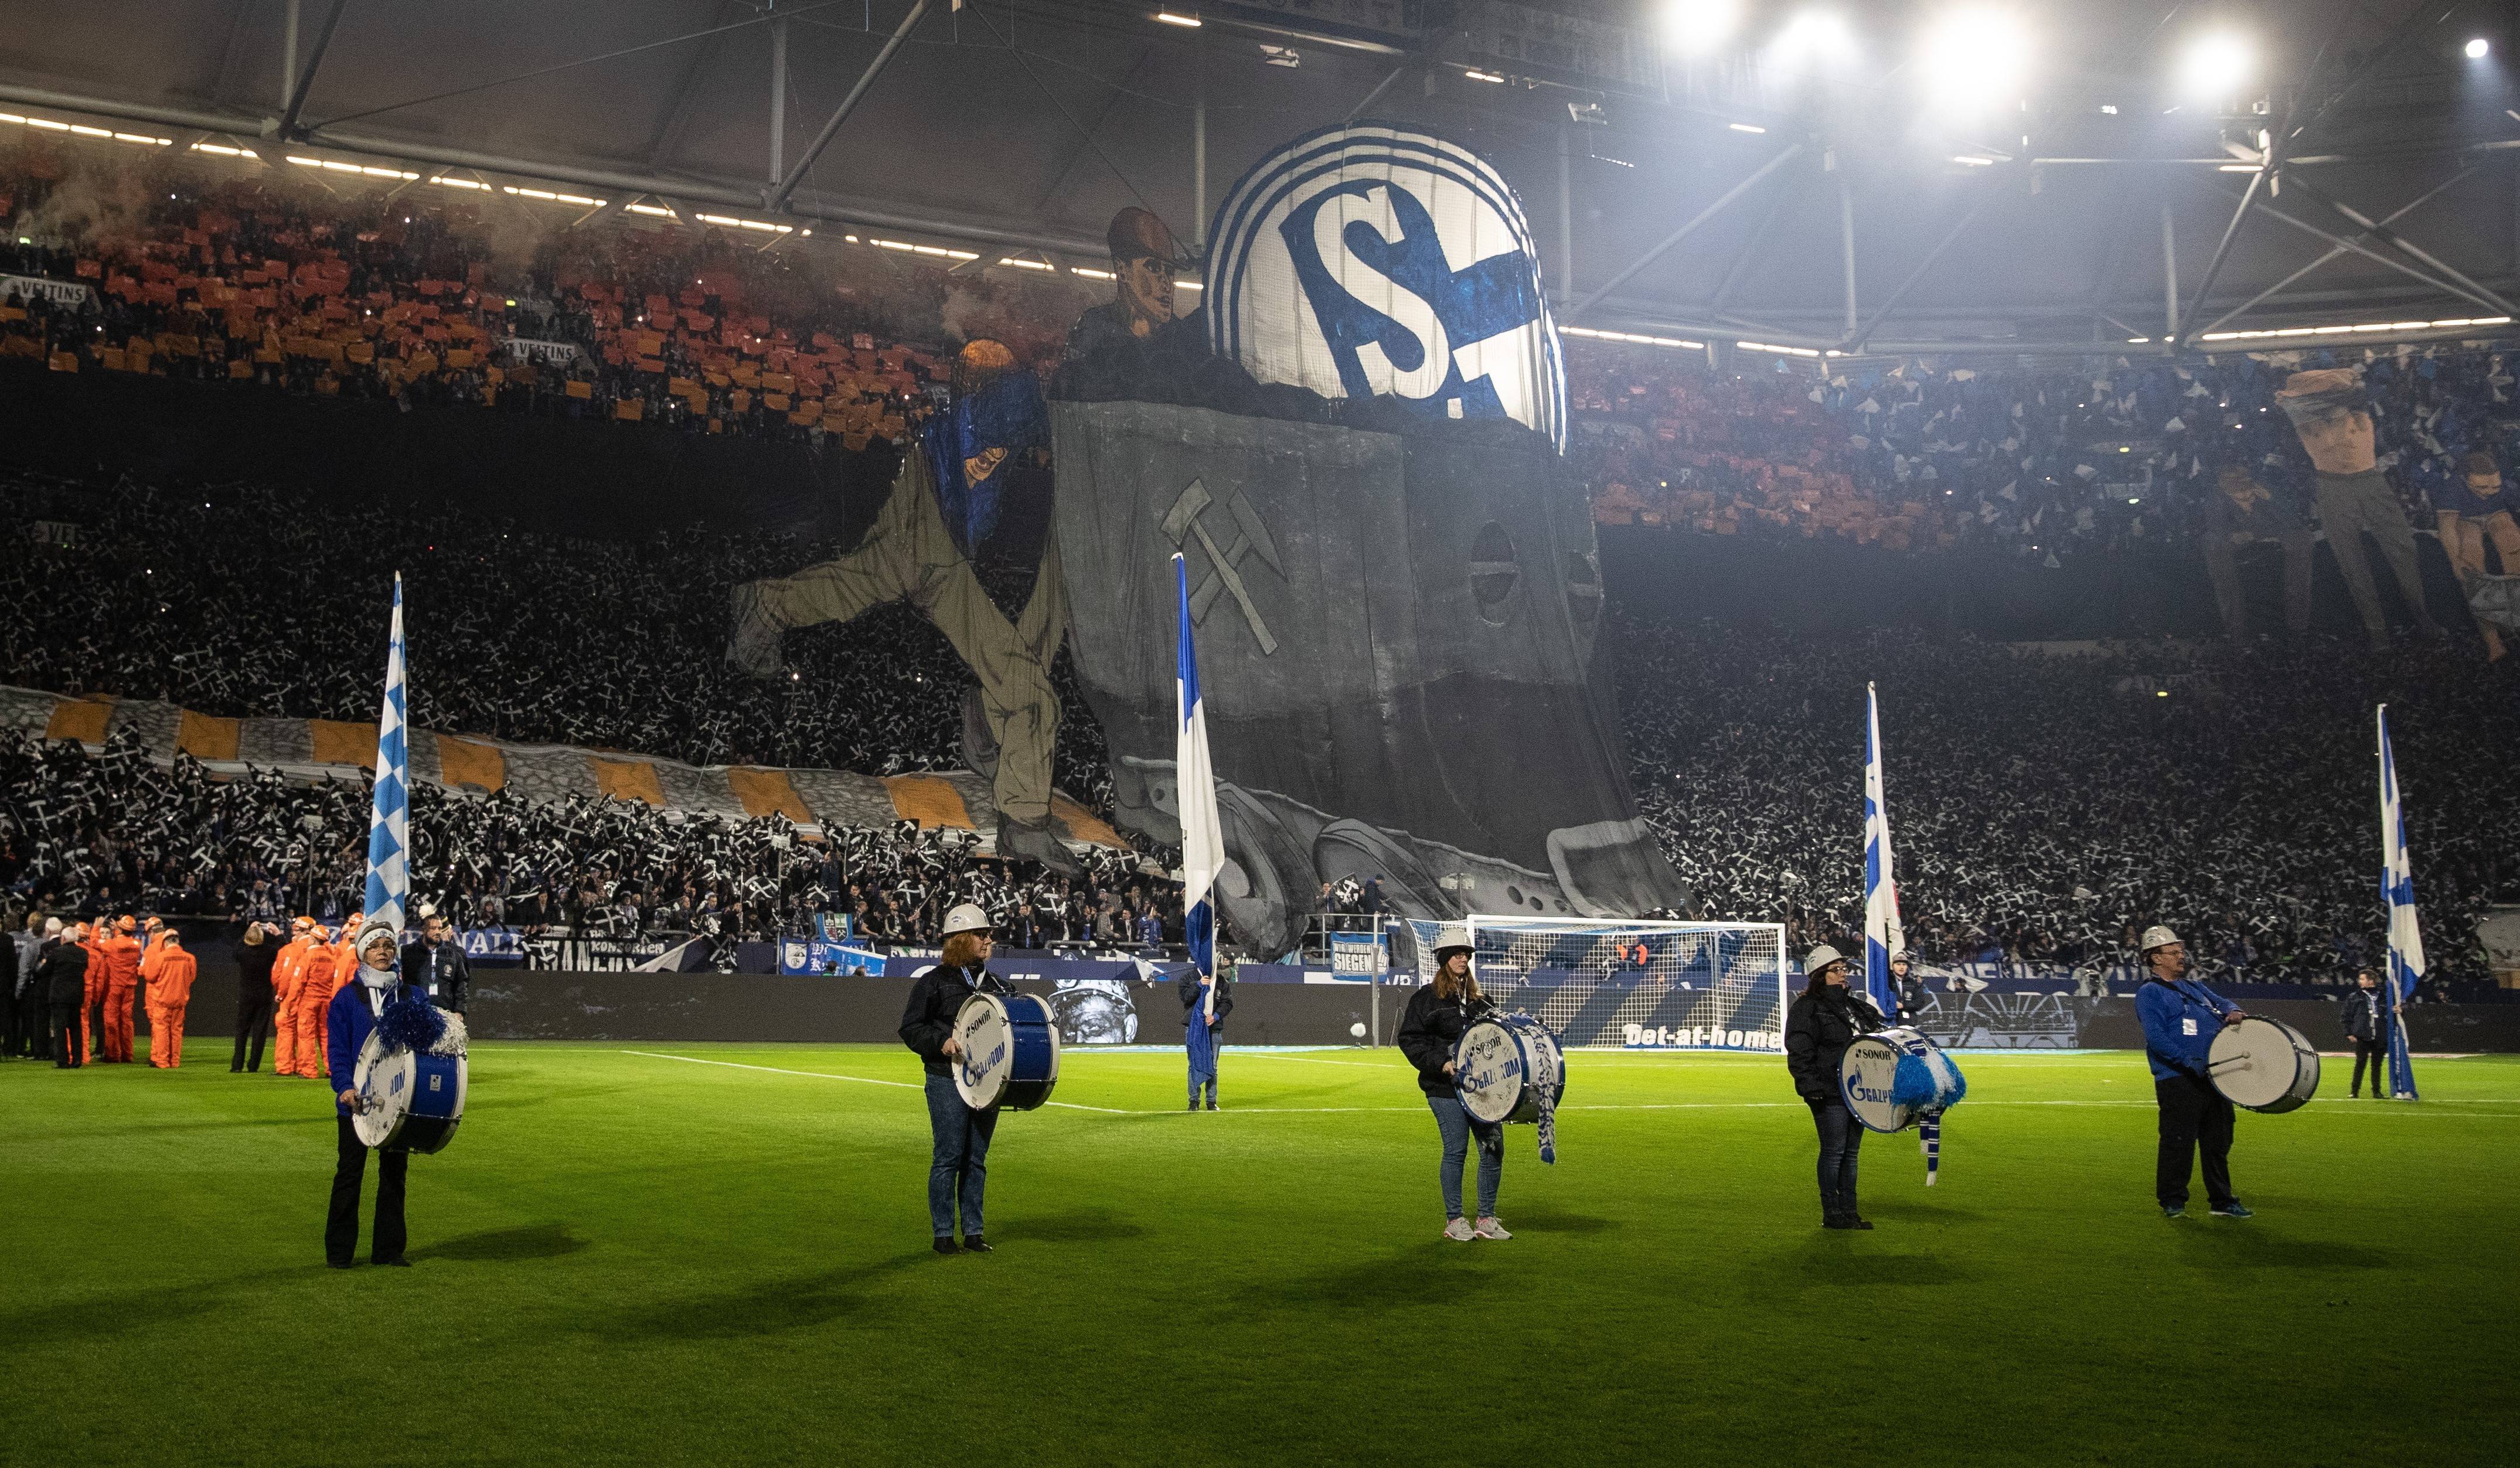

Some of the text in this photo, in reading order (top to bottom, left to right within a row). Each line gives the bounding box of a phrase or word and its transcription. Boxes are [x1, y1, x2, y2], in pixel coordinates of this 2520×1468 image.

[1334, 953, 1373, 972] SIEGEN
[970, 1009, 991, 1034] SONOR
[975, 1041, 1005, 1080] GAZPROM
[1862, 1049, 1891, 1060] SONOR
[1479, 1058, 1520, 1089] GAZOM
